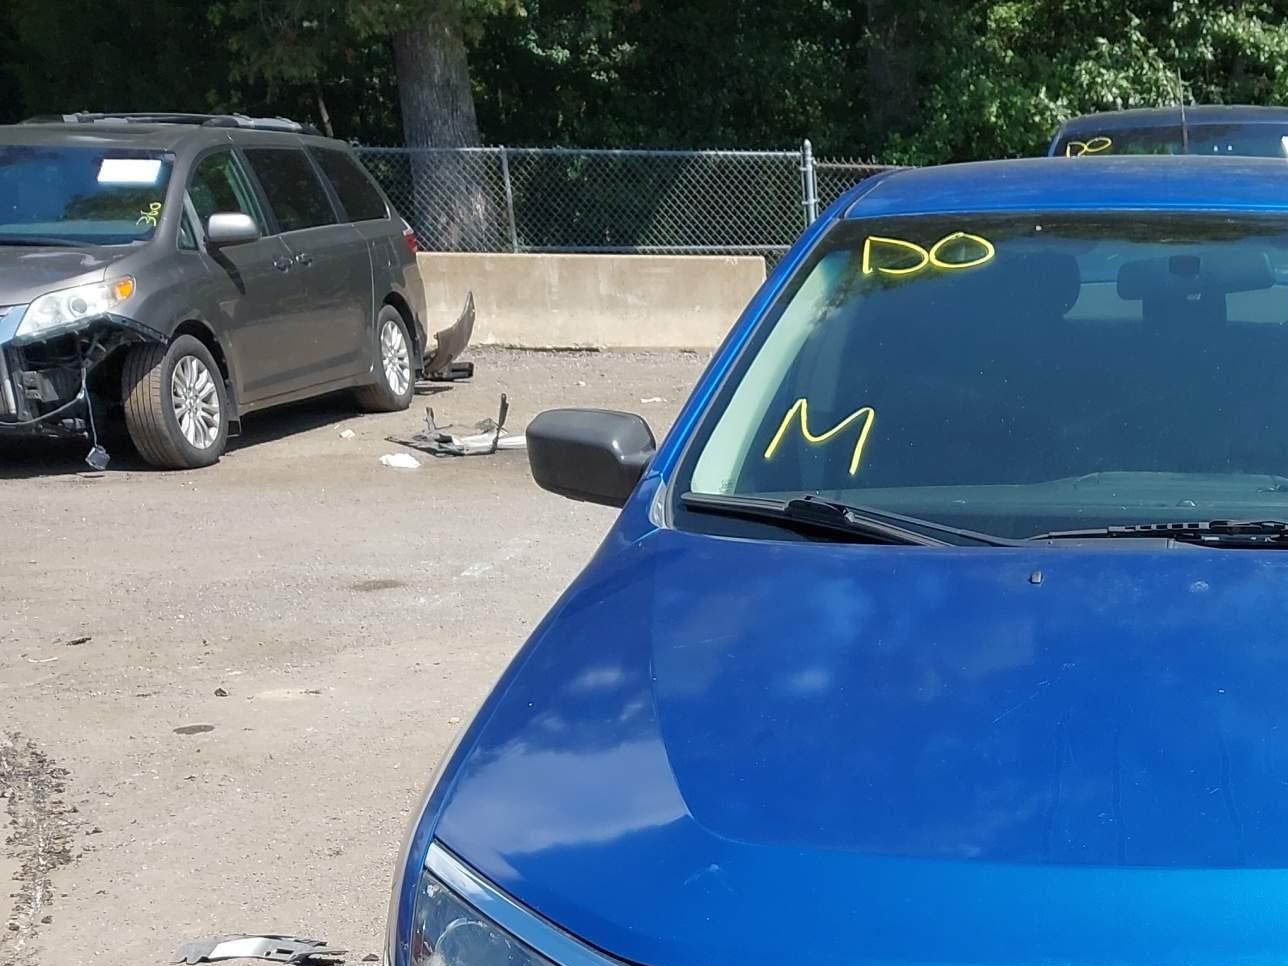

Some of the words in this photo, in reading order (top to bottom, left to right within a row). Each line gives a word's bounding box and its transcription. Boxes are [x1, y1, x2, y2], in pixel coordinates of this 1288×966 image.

[136, 202, 161, 226] 360
[862, 231, 996, 274] DO
[764, 398, 875, 475] M
